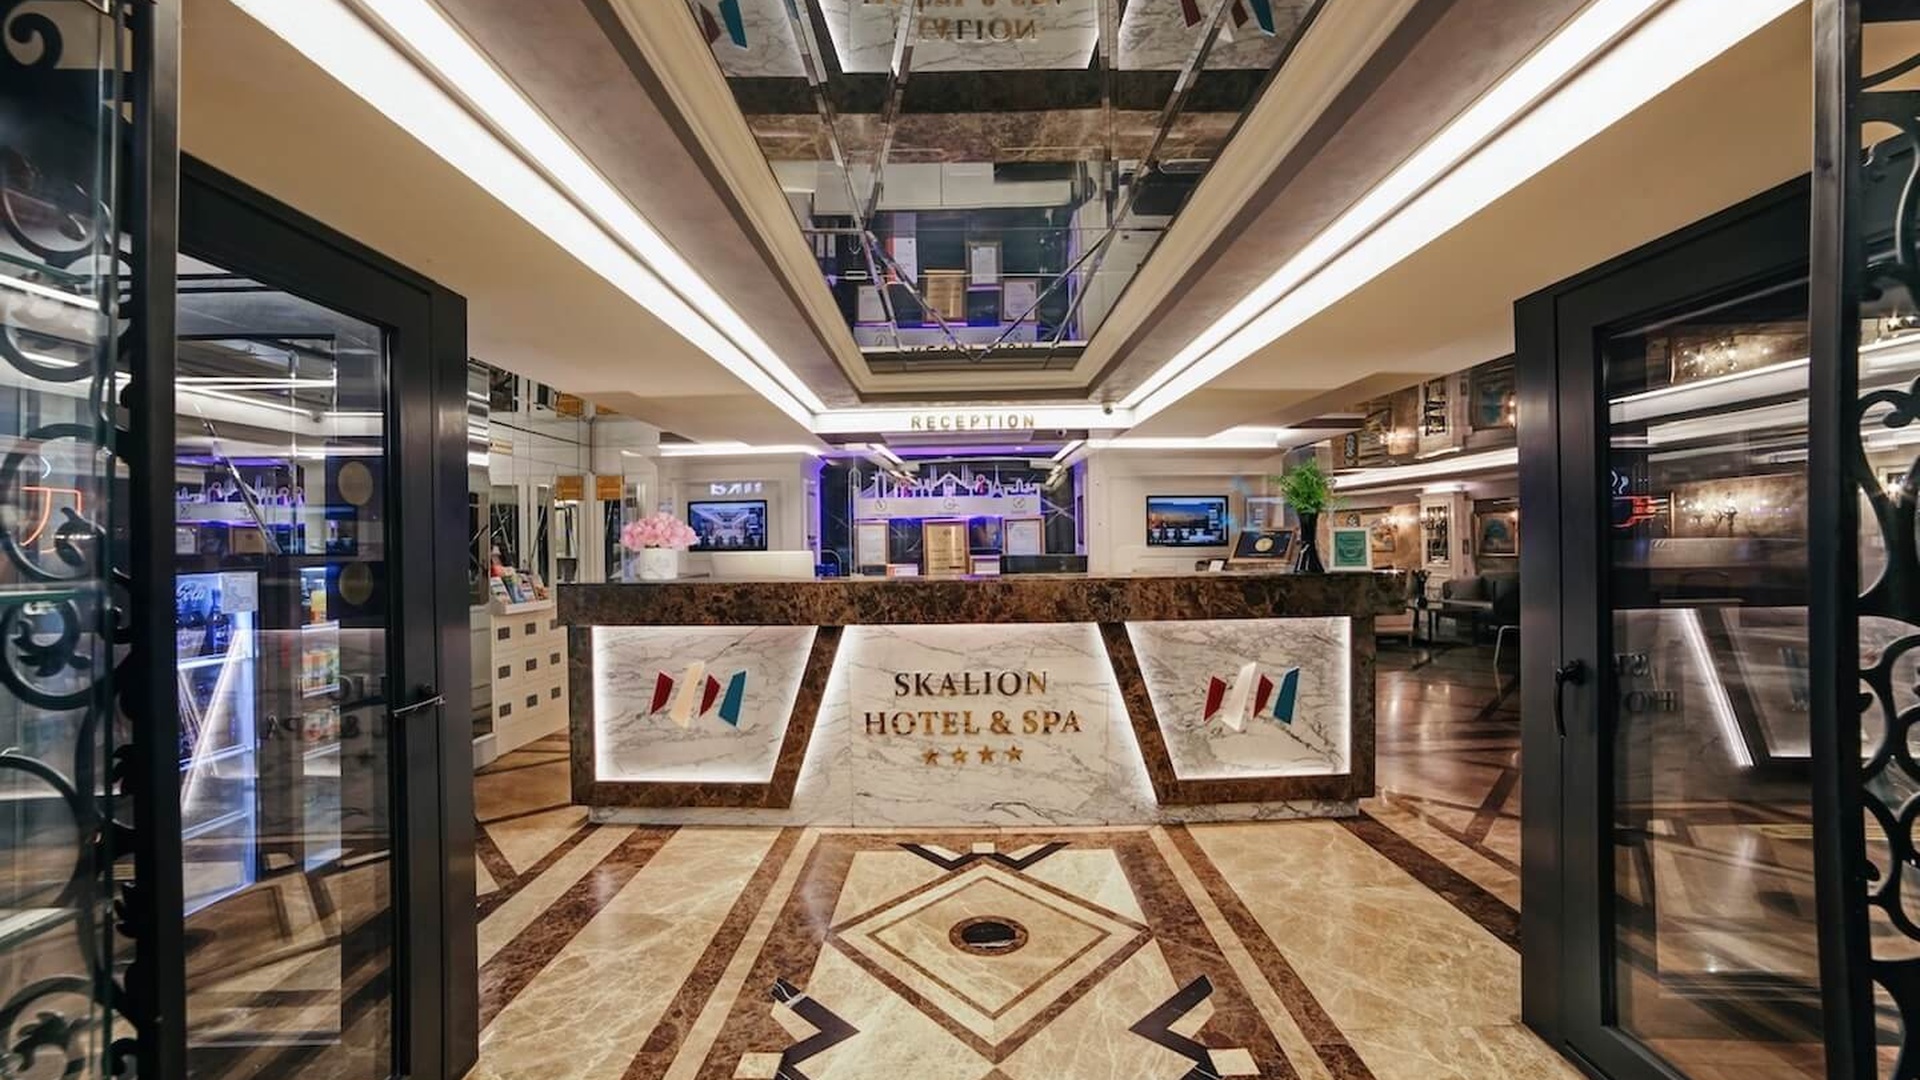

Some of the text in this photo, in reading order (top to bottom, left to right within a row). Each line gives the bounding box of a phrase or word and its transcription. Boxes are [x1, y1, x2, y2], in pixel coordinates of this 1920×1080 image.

[910, 414, 1036, 429] RECEPTION
[894, 671, 1047, 697] SKALION
[864, 710, 1082, 736] HOTEL & SPA
